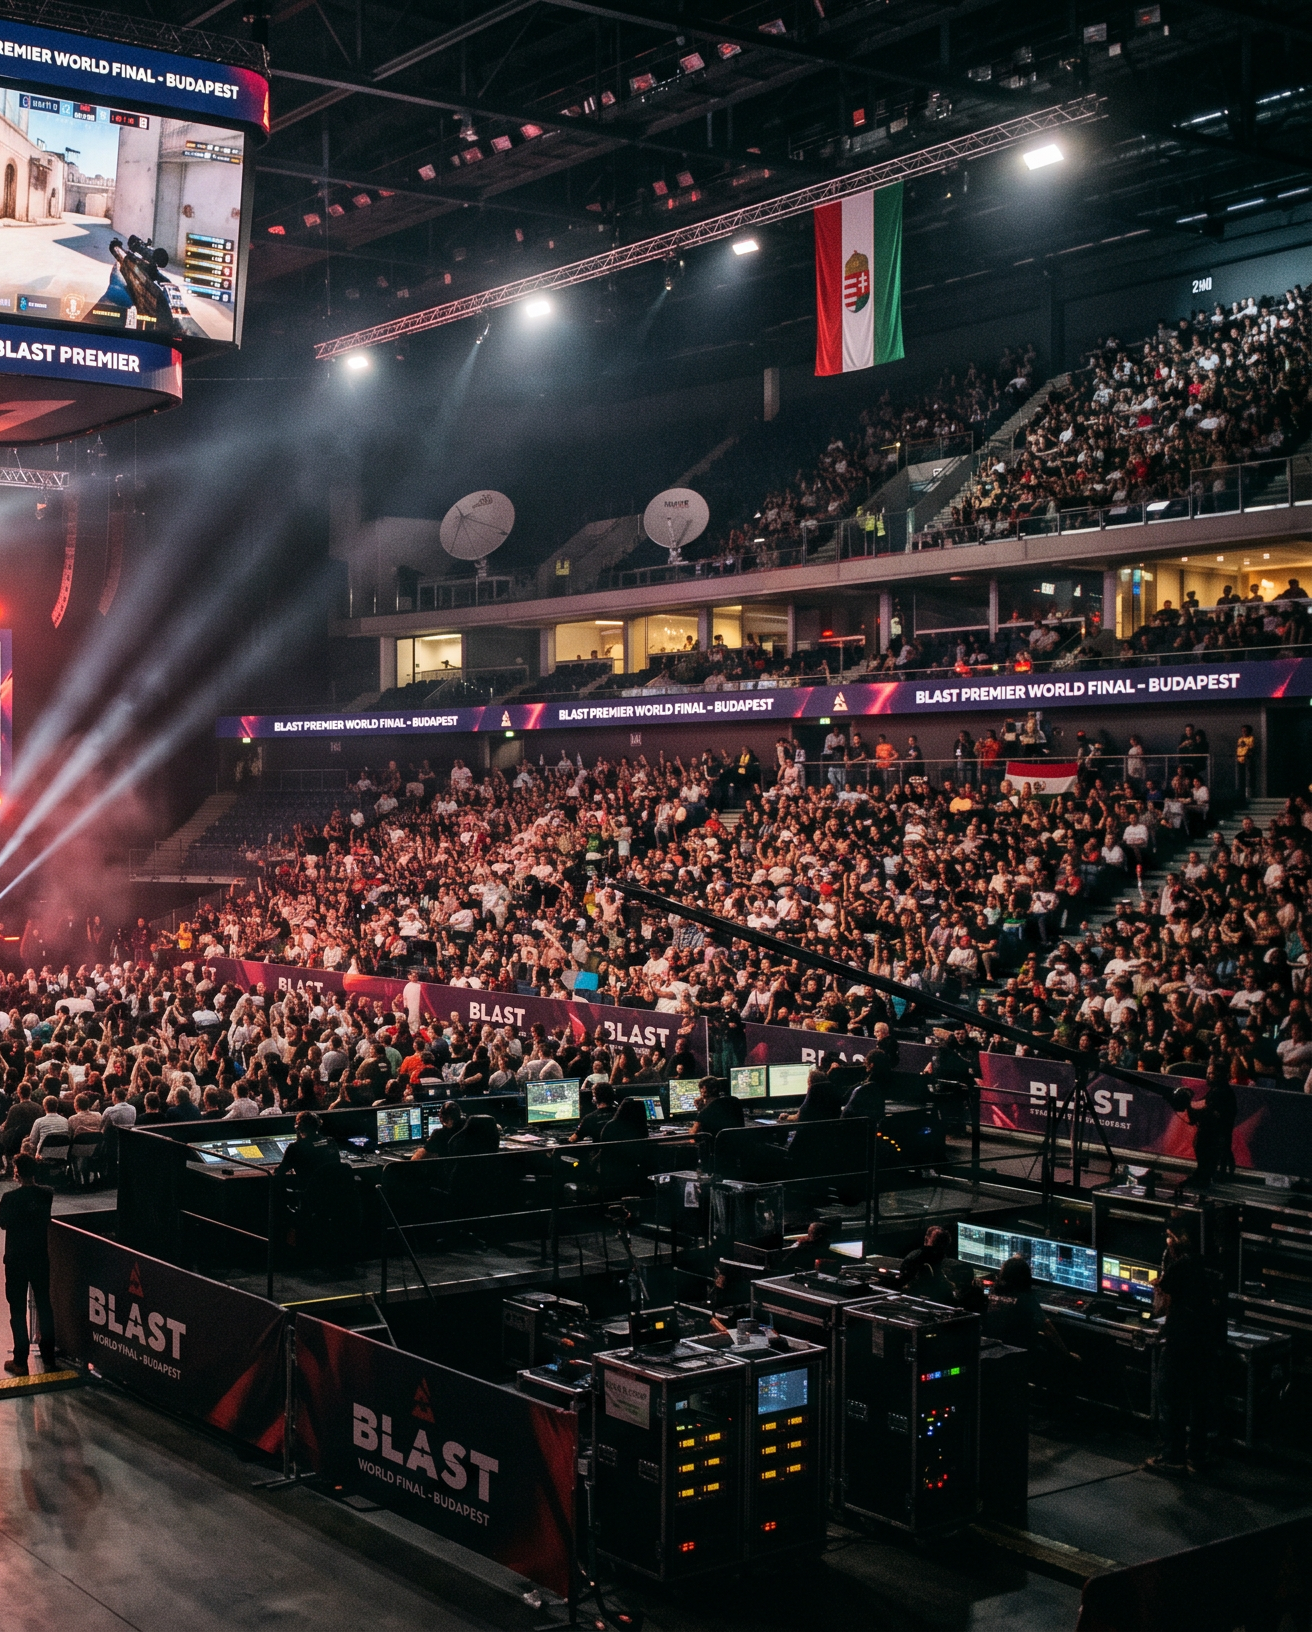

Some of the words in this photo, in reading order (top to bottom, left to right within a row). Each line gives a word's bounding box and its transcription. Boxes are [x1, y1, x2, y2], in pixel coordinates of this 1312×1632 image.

[54, 52, 110, 75] WORLD
[112, 62, 156, 84] FINAL
[166, 73, 240, 100] BUDAPEST
[60, 345, 140, 372] PREMIER
[915, 689, 960, 704] BLAST
[961, 685, 1026, 701] PREMIER
[1027, 682, 1085, 698] WORLD
[1088, 679, 1136, 695] FINAL
[1148, 673, 1240, 692] BUDAPEST
[559, 708, 589, 720] BLAST
[589, 706, 634, 719] PREMIER
[634, 704, 673, 716] WORLD
[674, 702, 706, 714] FINAL
[714, 698, 774, 713] BUDAPEST
[274, 721, 303, 732] BLAST
[304, 720, 345, 731] PREMIER
[345, 719, 378, 730] WORLD
[379, 718, 406, 728] FINAL
[412, 716, 458, 727] BUDAPEST
[469, 1001, 526, 1027] BLAST
[604, 1021, 670, 1048] BLAST
[89, 1285, 187, 1360] BLAST
[353, 1402, 499, 1504] BLAST
[357, 1457, 394, 1484] WORLD
[396, 1475, 426, 1499] FINAL
[433, 1491, 490, 1527] BUDAPEST
